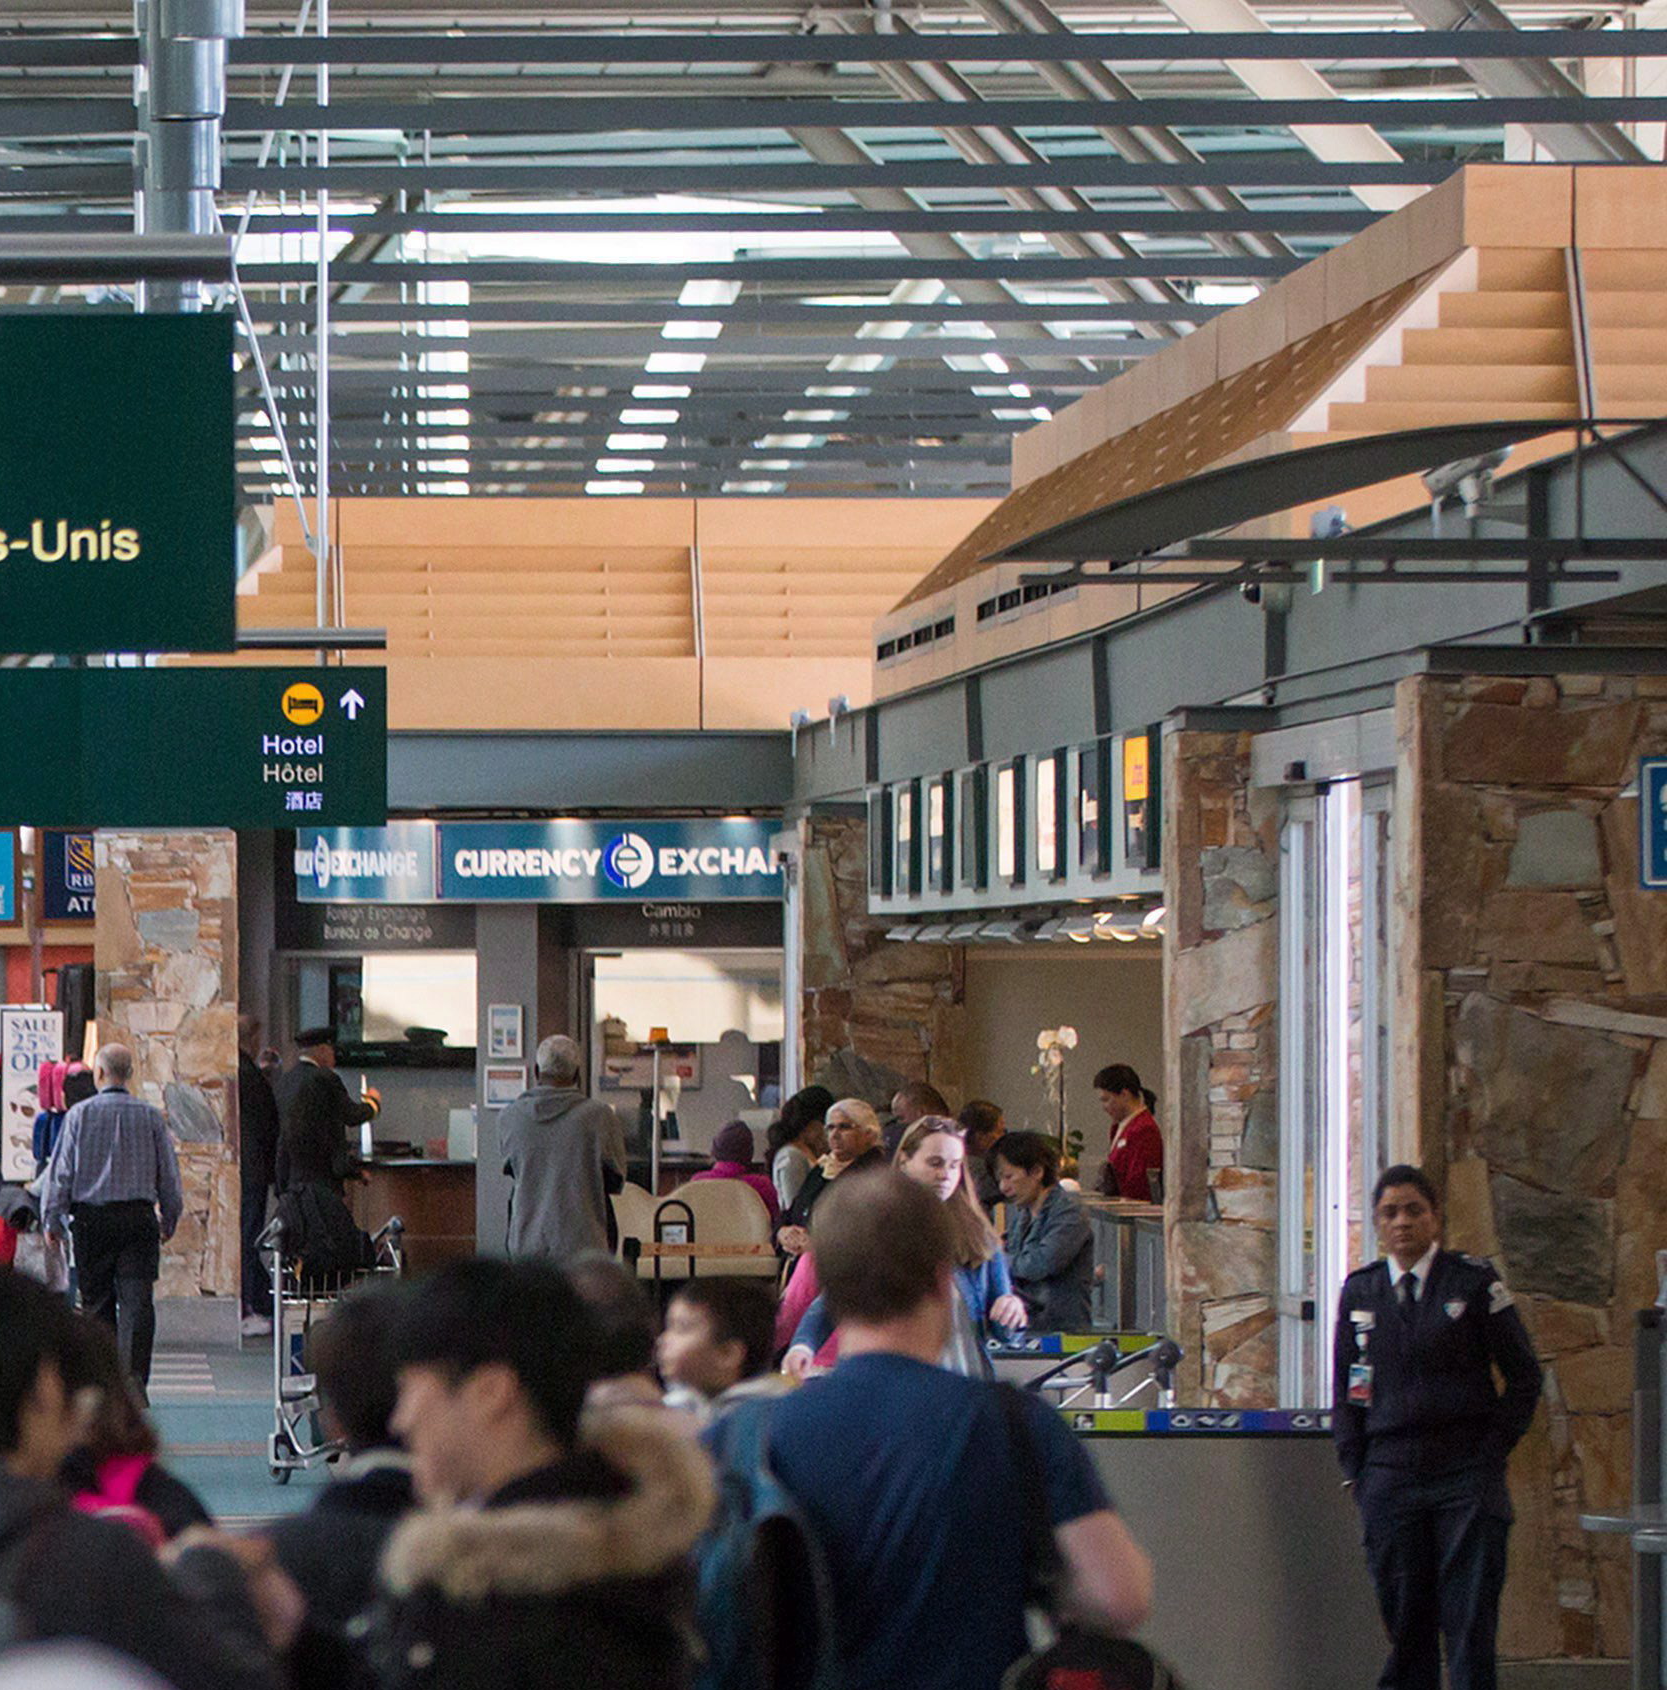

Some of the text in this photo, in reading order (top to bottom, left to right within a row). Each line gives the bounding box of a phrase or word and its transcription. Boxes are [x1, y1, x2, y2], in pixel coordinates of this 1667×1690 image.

[263, 734, 324, 756] Hotel
[264, 762, 323, 783] Hôtel
[285, 791, 324, 811] 酒店
[330, 848, 418, 878] EXCHANGE
[454, 848, 603, 877] CURRENCY
[641, 902, 702, 919] Cambio
[323, 924, 434, 943] Bureau de Change
